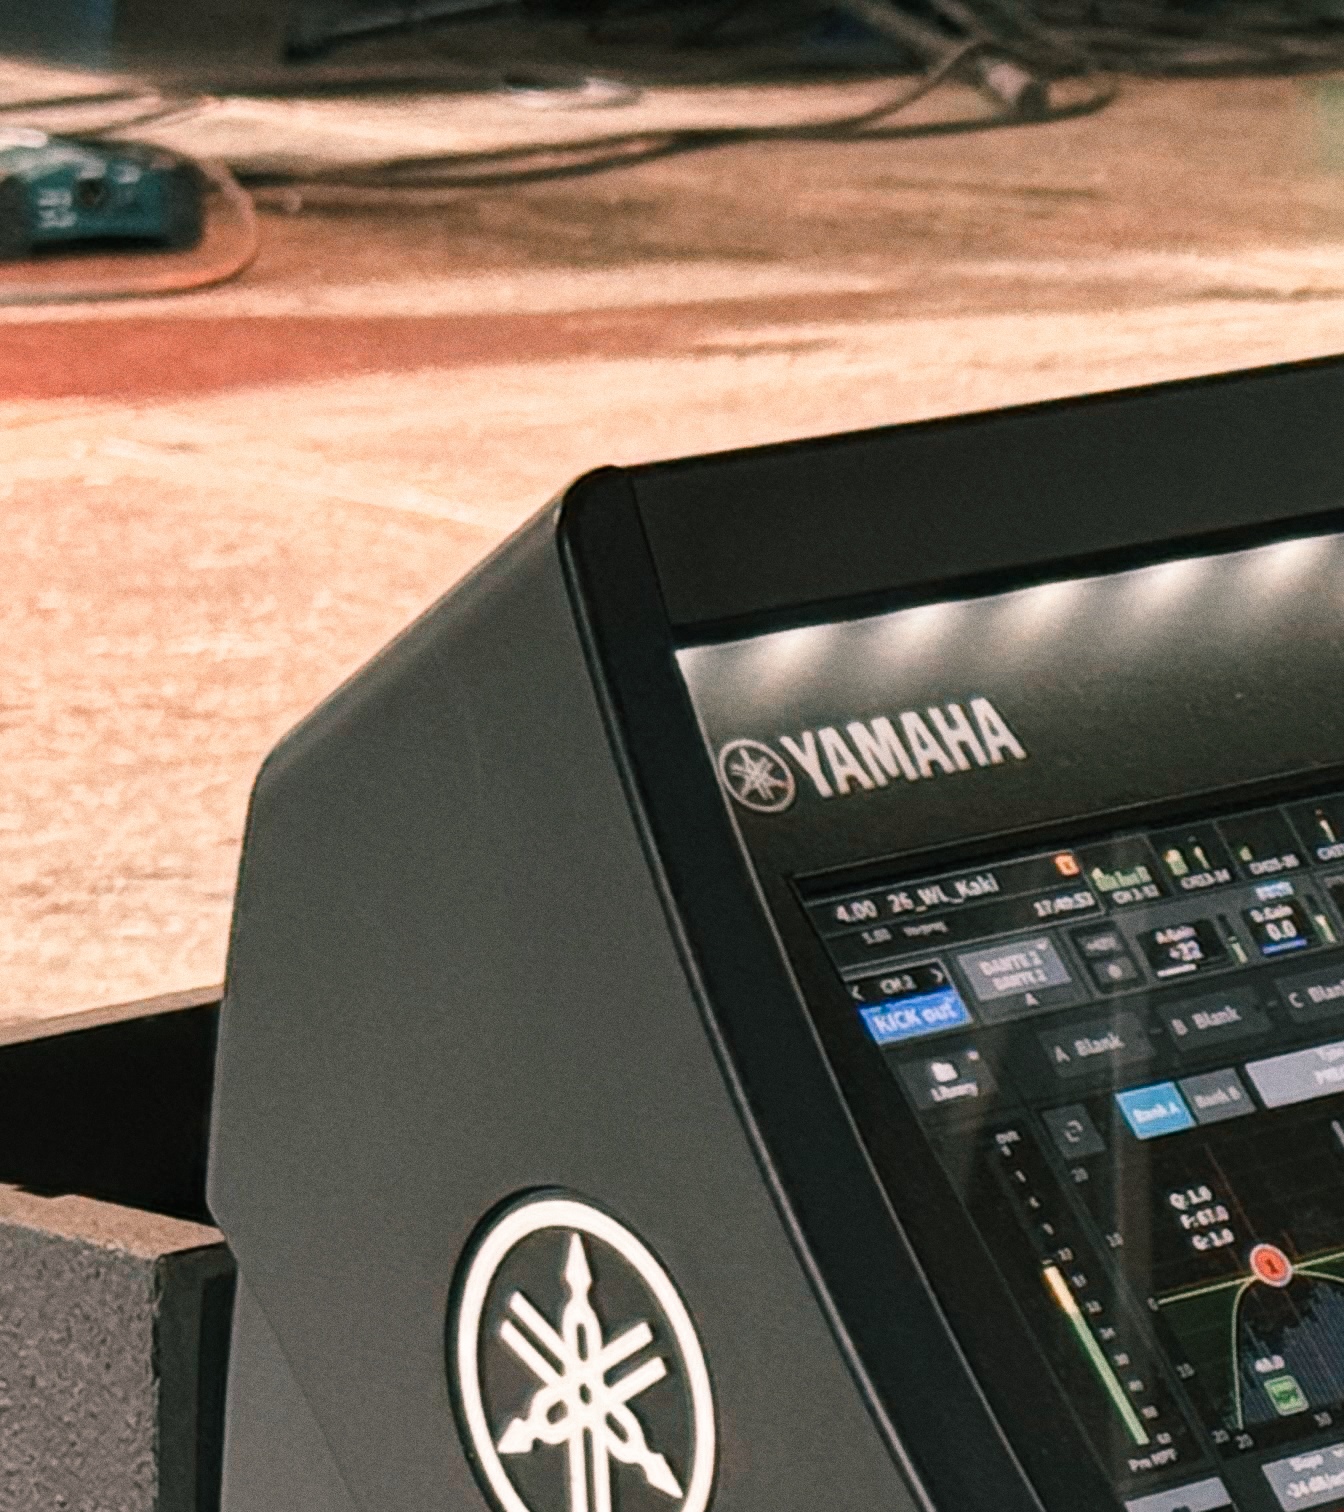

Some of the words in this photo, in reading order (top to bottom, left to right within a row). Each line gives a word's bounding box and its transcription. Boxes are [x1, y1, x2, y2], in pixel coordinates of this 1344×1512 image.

[780, 697, 1028, 797] YAMAHA
[834, 899, 879, 923] 4.00
[1264, 919, 1298, 941] 0.0
[1023, 992, 1039, 1007] A
[1287, 992, 1304, 1009] C
[872, 1008, 923, 1034] KICK
[920, 999, 958, 1024] out
[1171, 1019, 1189, 1036] B
[1191, 1004, 1242, 1031] Blank
[1053, 1046, 1070, 1063] A
[1073, 1031, 1126, 1058] Blank
